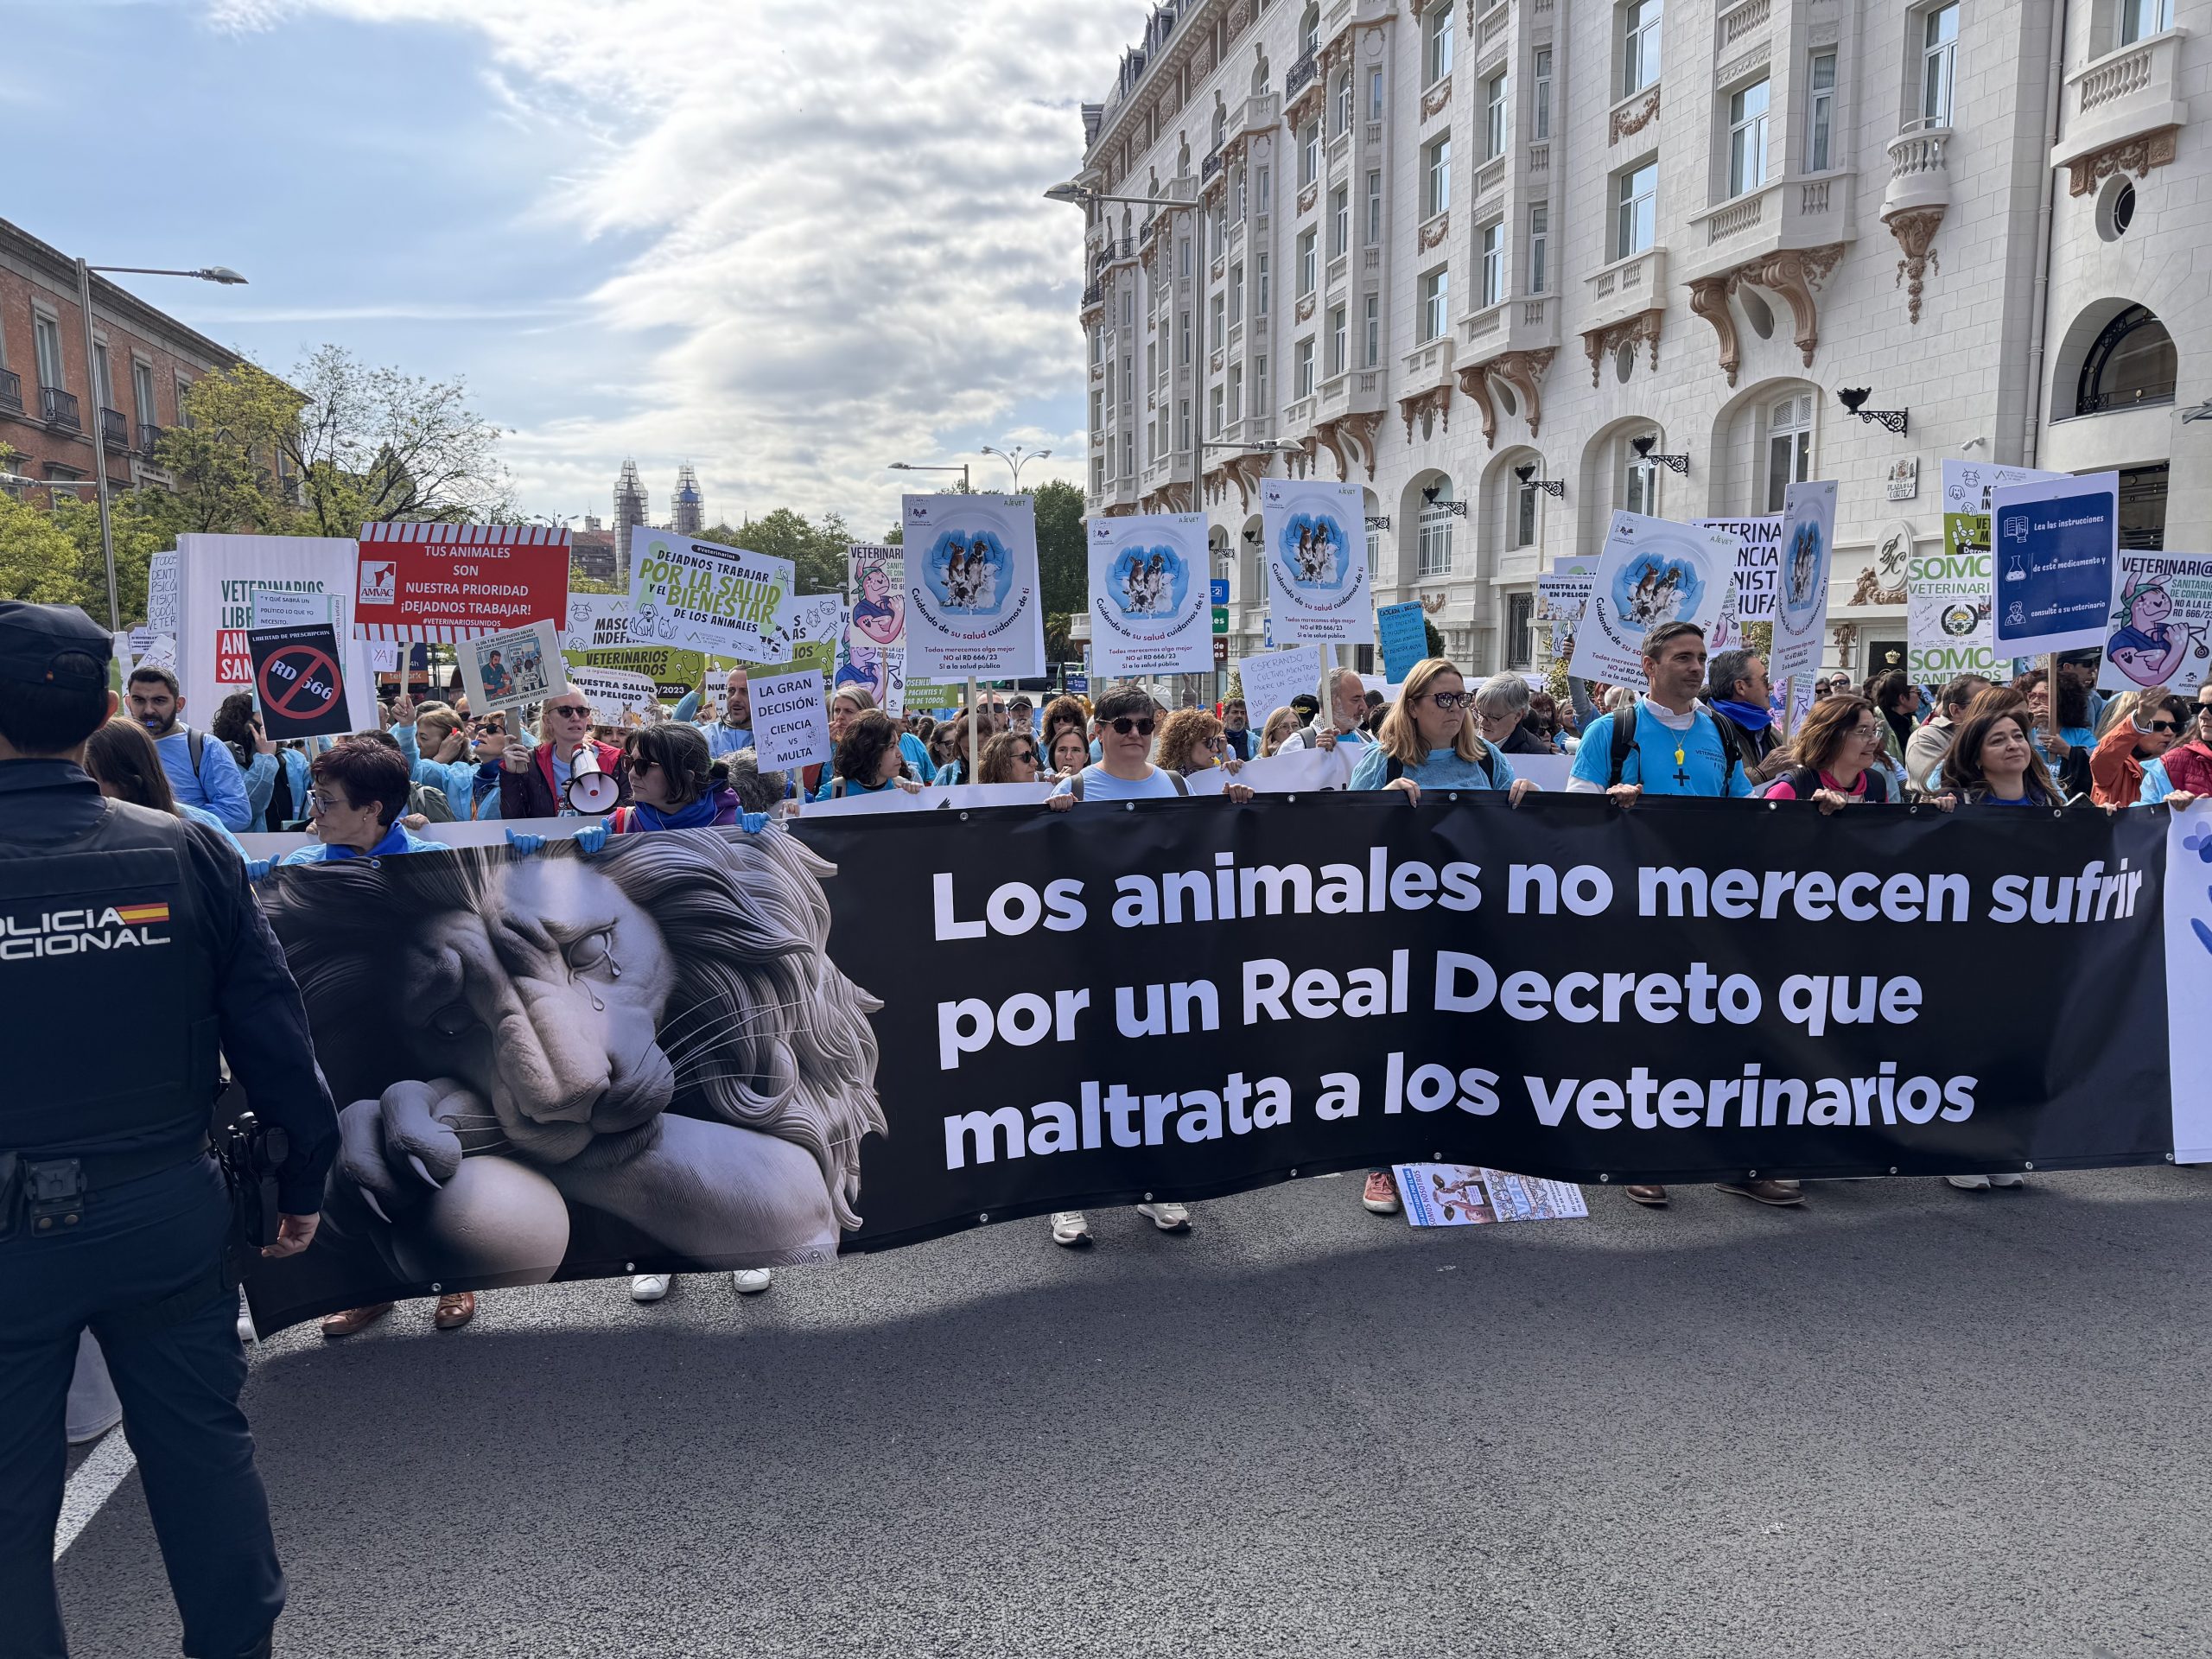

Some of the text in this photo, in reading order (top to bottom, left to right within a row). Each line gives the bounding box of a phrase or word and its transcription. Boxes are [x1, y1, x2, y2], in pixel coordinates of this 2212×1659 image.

[2034, 523, 2045, 531] Lea
[2058, 515, 2104, 528] instrucciones
[425, 546, 511, 559] TUS ANIMALES
[453, 565, 479, 577] SON
[658, 550, 769, 583] DEJADNOS TRABAJAR
[2033, 556, 2101, 573] de este medicamento
[2122, 557, 2212, 578] VETERINARI@
[405, 582, 529, 597] NUESTRA PRIORIDAD
[639, 558, 780, 605] POR LA SALUD
[1272, 563, 1294, 599] Cuidando
[1294, 596, 1303, 606] de
[1313, 602, 1332, 611] salud
[1333, 584, 1358, 608] cuidamos
[361, 588, 394, 597] AMVAC
[2171, 589, 2180, 598] DE
[401, 601, 531, 617] ¡DEJADNOS TRABAJAR!
[649, 583, 774, 624] Y EL BIENESTAR
[2031, 607, 2057, 617] consulte
[2071, 601, 2106, 612] veterinario
[673, 608, 758, 632] DE LOS ANIMALES
[912, 588, 938, 626] Cuidando
[938, 624, 950, 634] de
[963, 630, 986, 639] salud
[988, 608, 1021, 637] cuidamos
[1020, 595, 1027, 607] de
[1096, 598, 1120, 631] Cuidando
[1122, 628, 1131, 637] de
[1143, 632, 1165, 641] salud
[1167, 611, 1198, 638] cuidamos
[1196, 600, 1204, 610] de
[1596, 597, 1612, 636] Cuidando
[1611, 636, 1621, 645] de
[2173, 608, 2183, 617] RD
[423, 618, 501, 627] #VETERINARIOSUNIDOS
[586, 651, 669, 666] VETERINARIOS
[1251, 654, 1303, 672] ESPERANDO
[270, 660, 297, 681] RD
[1287, 664, 1319, 675] MIENTRAS
[572, 678, 620, 689] NUESTRA
[622, 683, 655, 693] SALUD
[760, 678, 811, 697] LA GRAN
[600, 690, 642, 701] PELIGRO
[759, 696, 818, 717] DECISIÓN:
[771, 719, 812, 735] CIENCIA
[778, 747, 812, 762] MULTA
[932, 846, 2142, 941] Los animales no merecen sufrir
[938, 949, 1923, 1071] por un Real Decreto que
[944, 1052, 1979, 1171] maltrata a los veterinarios
